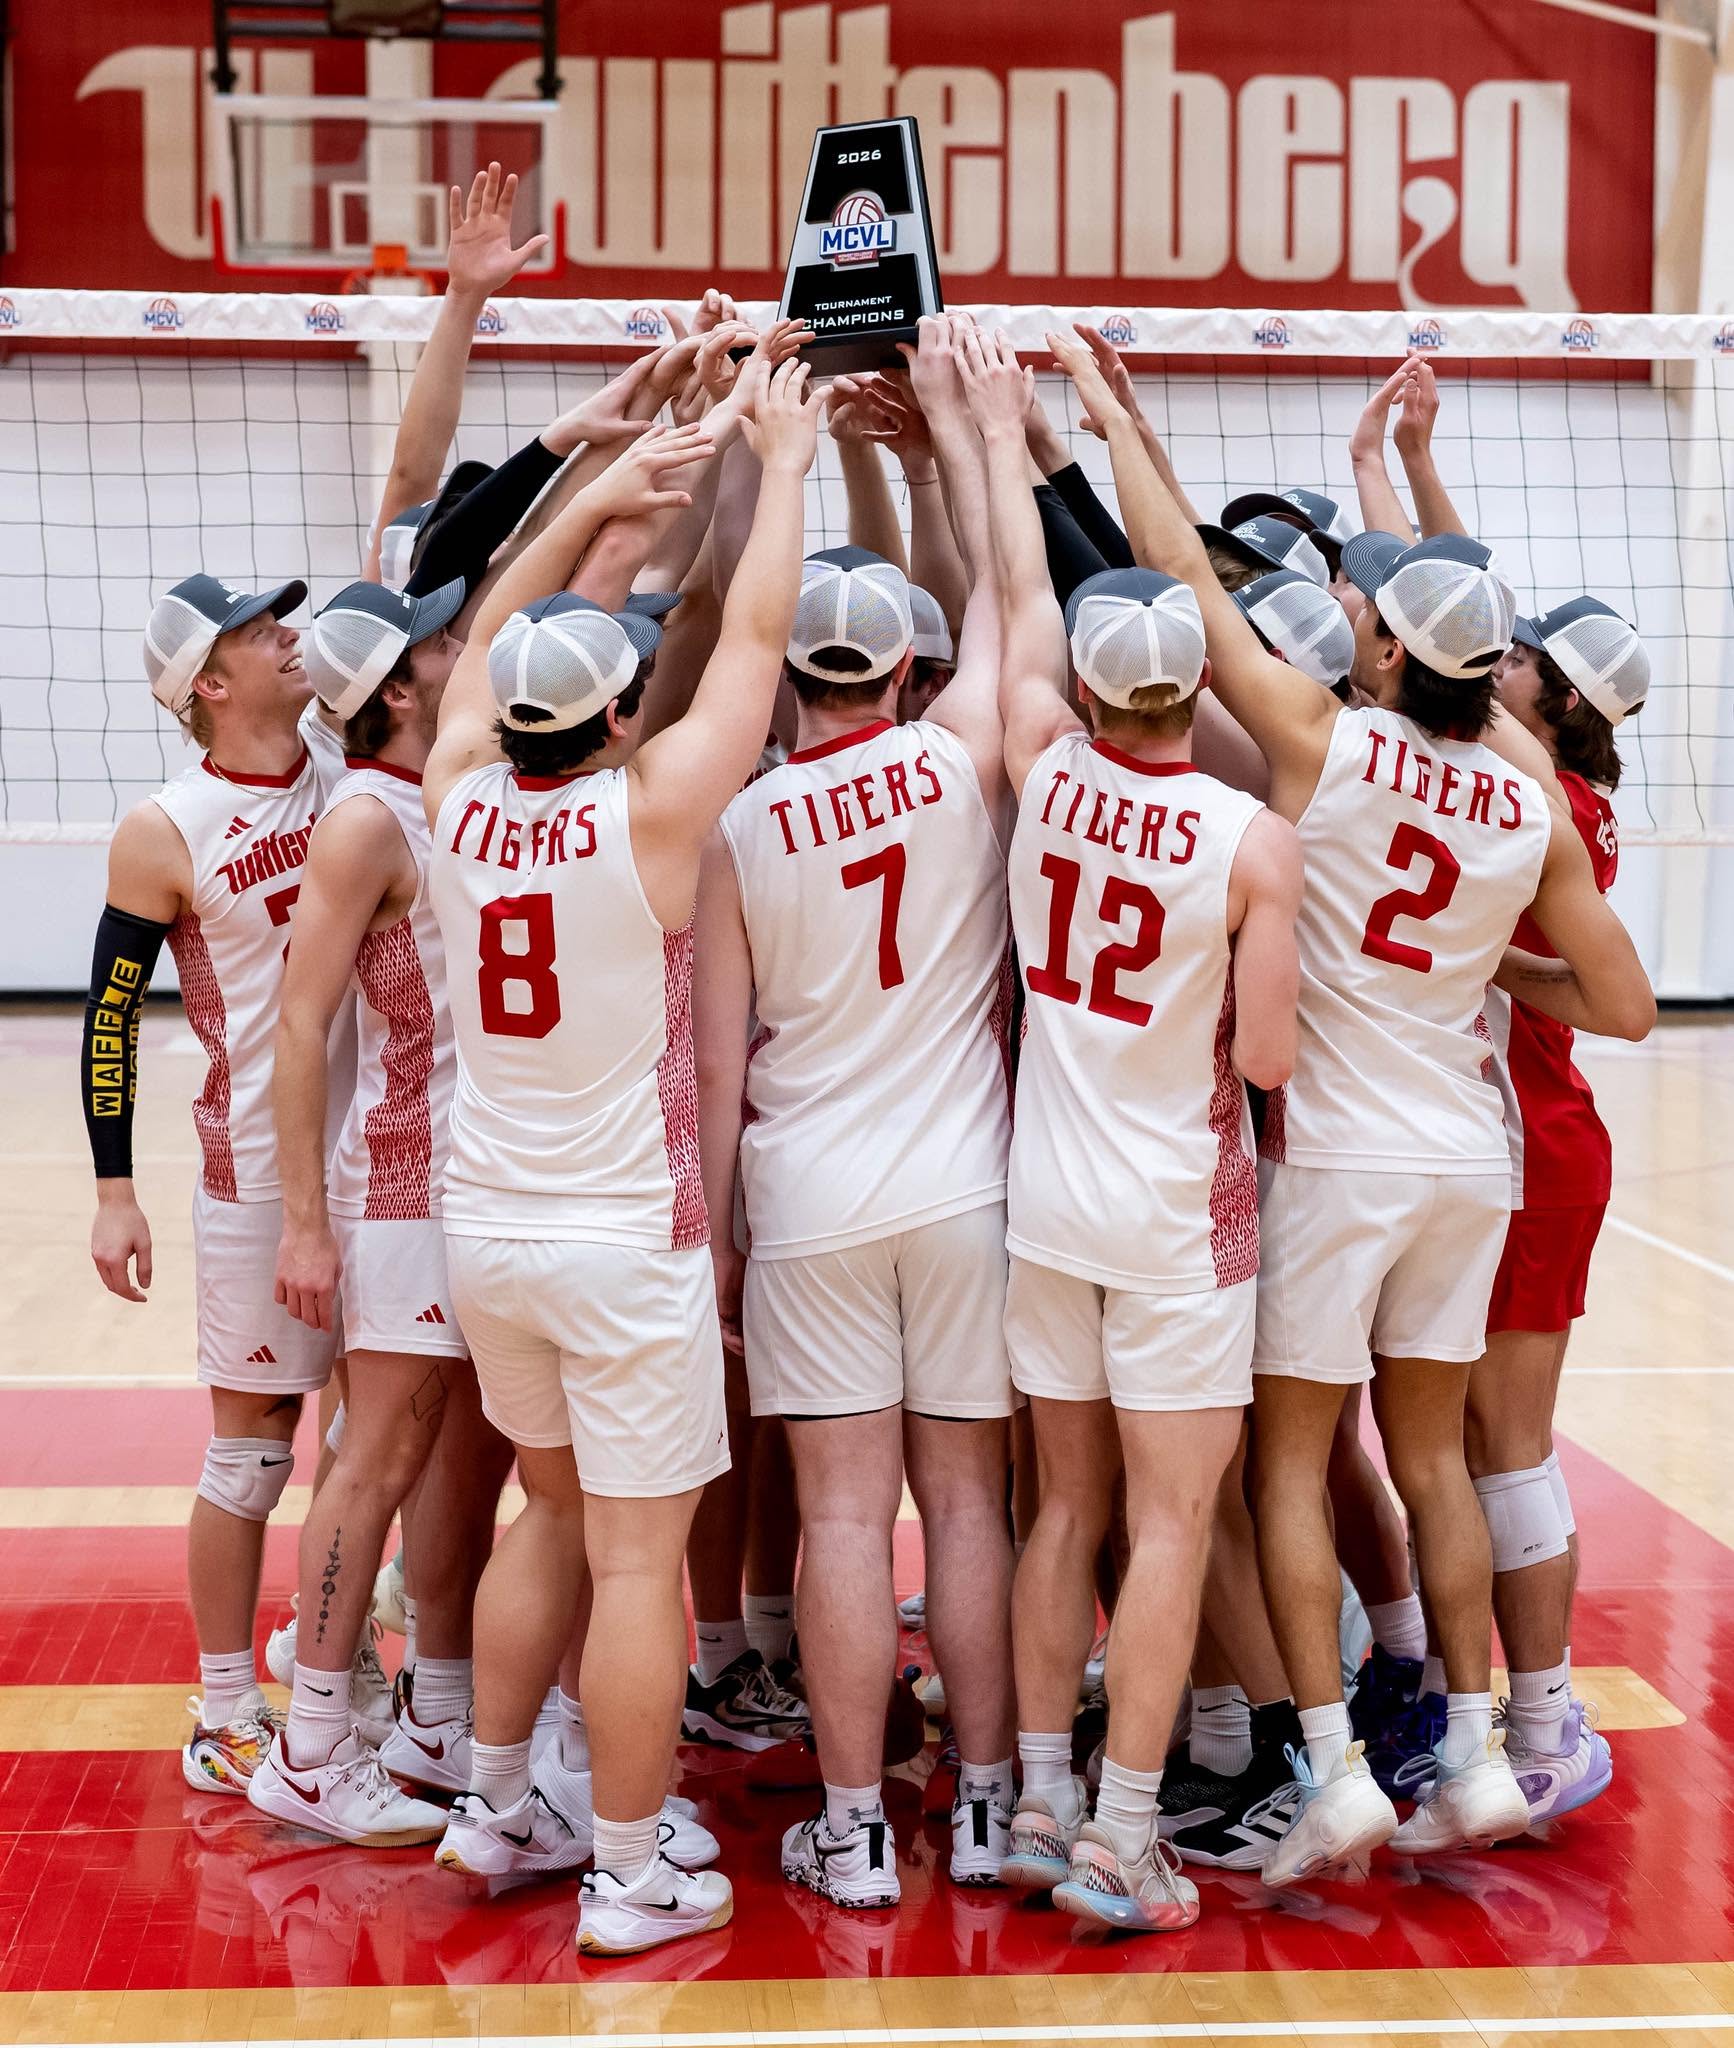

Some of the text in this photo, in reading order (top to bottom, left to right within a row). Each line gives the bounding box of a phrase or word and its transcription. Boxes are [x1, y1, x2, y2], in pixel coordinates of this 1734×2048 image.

[838, 150, 881, 165] 2026
[823, 224, 889, 252] MCVL
[815, 296, 892, 311] TOURNAMENT
[144, 313, 183, 327] MCVL
[306, 316, 345, 329] MCVL
[480, 319, 504, 331] CVL
[626, 320, 664, 335] MCVL
[803, 309, 904, 330] CHAMPIONS
[1255, 332, 1290, 344] MCVL
[1409, 333, 1445, 346] MCVL
[1562, 334, 1596, 347] MCVL
[1361, 729, 1522, 831] TIGERS
[769, 749, 943, 856] TIGERS
[1360, 822, 1461, 973] 2
[841, 842, 907, 990] 7
[1026, 852, 1166, 1027] 12
[478, 892, 562, 1039] 8
[93, 957, 142, 1116] WAFFLE
